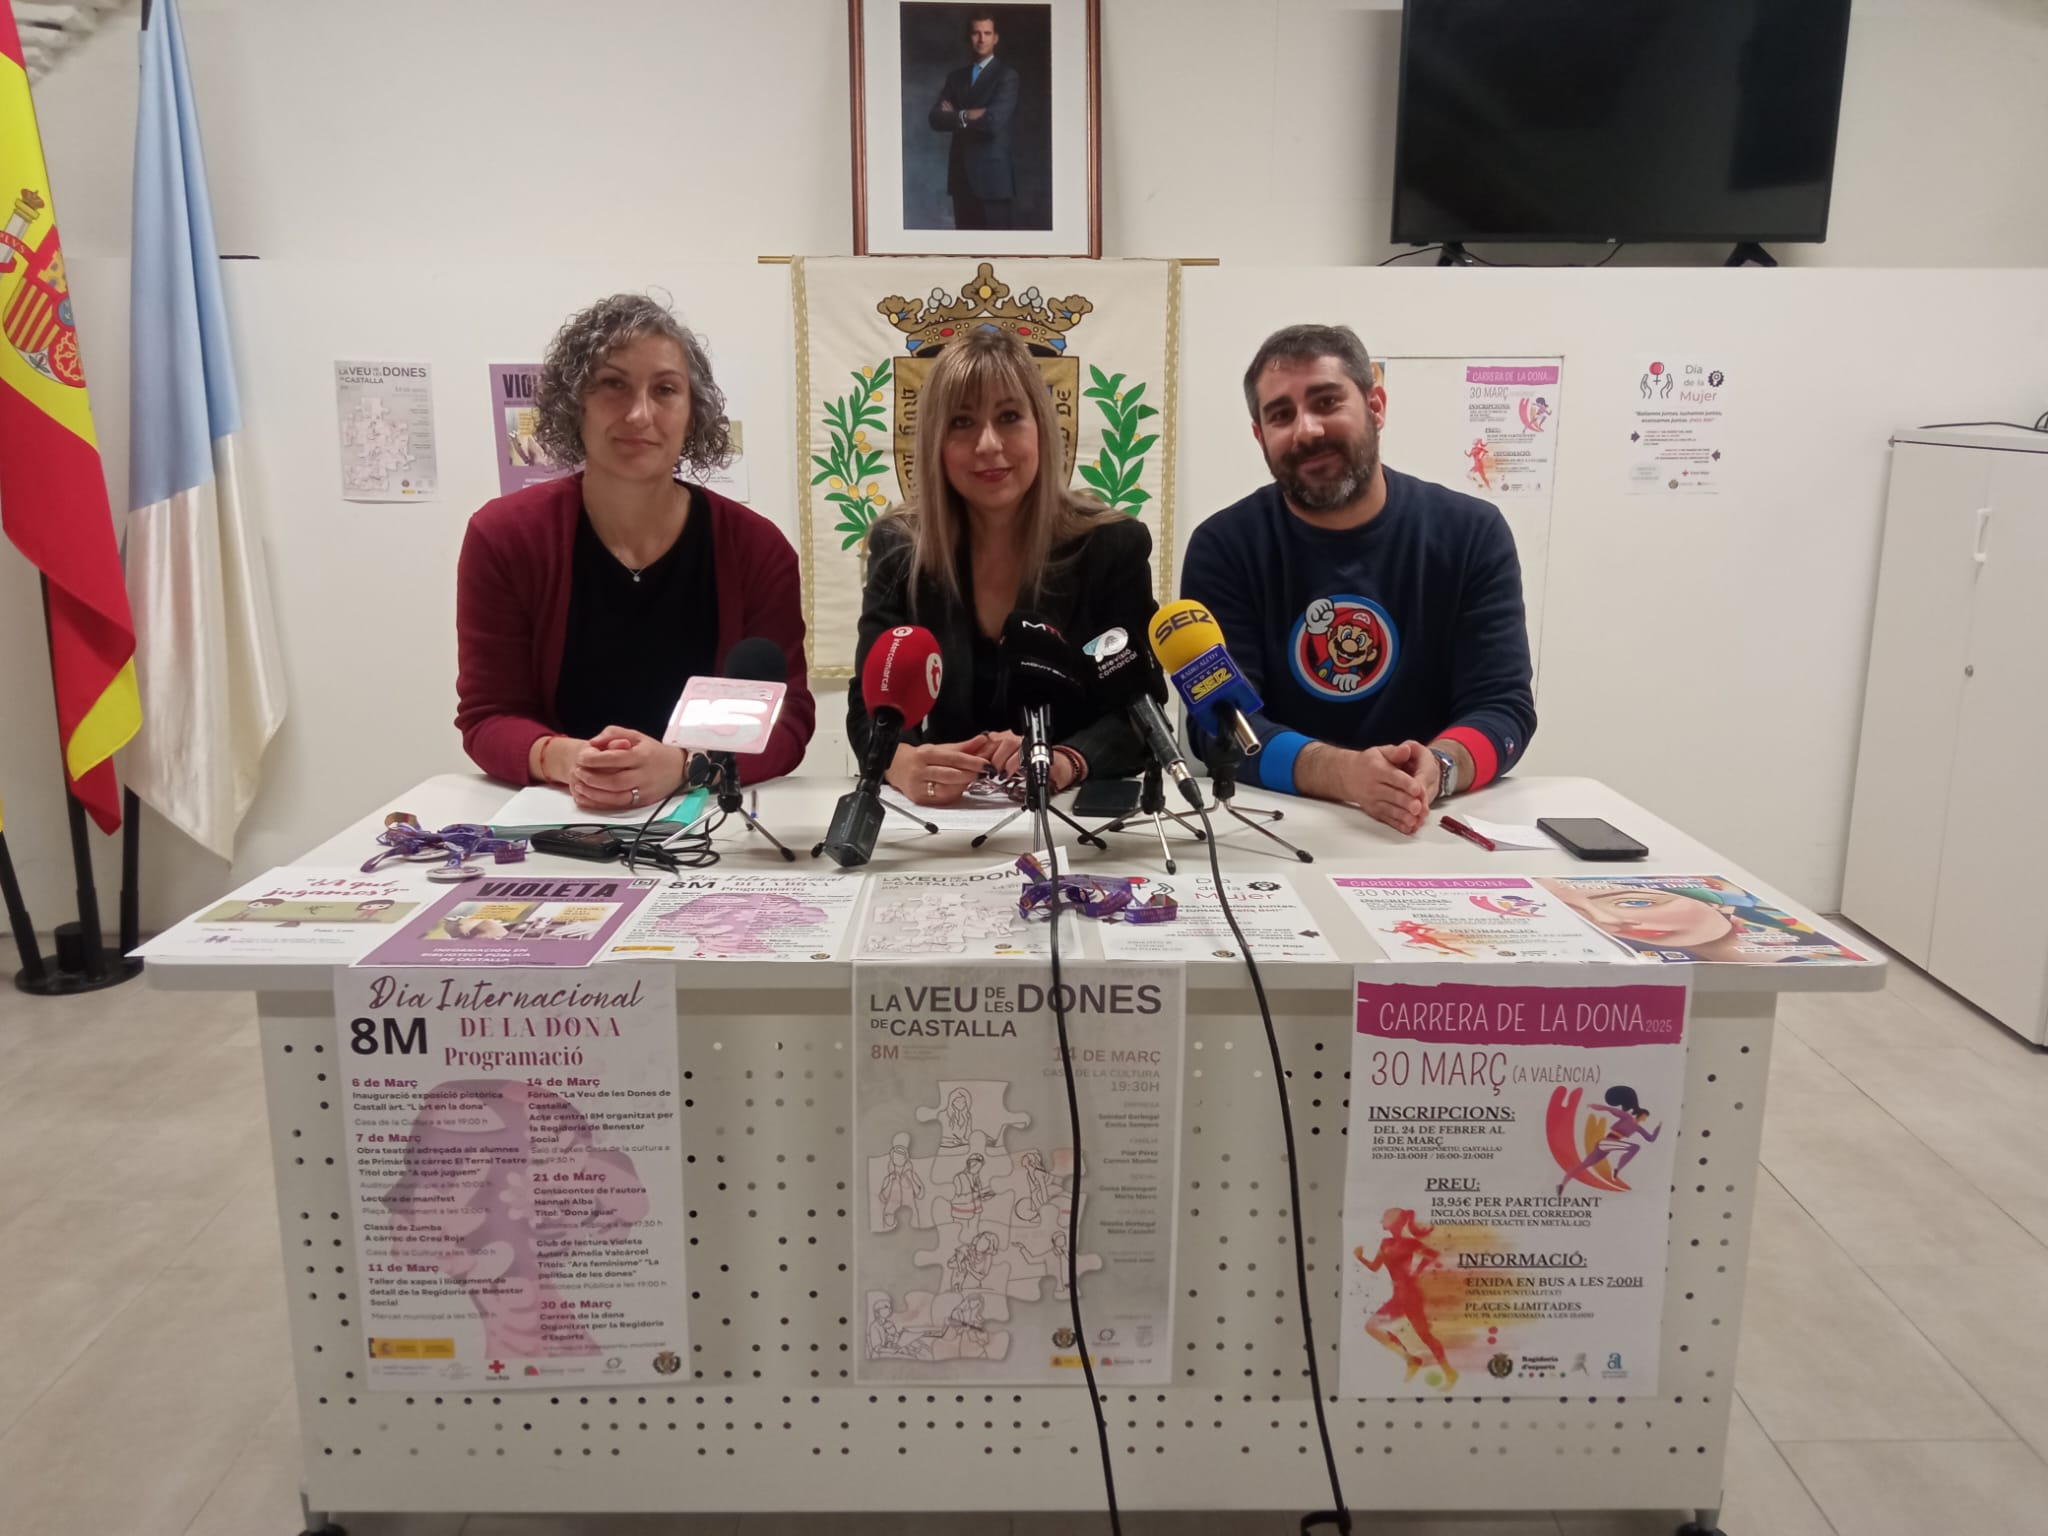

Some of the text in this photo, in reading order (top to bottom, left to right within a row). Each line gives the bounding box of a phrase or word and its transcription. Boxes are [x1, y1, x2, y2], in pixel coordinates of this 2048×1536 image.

[349, 367, 371, 376] VEU
[382, 366, 426, 377] DONES
[1685, 364, 1703, 374] Día
[344, 376, 384, 384] CASTALLA
[1517, 372, 1526, 380] LA
[1528, 371, 1548, 381] DONA
[1470, 387, 1509, 400] 30 MARÇ
[1680, 392, 1717, 404] Mujer
[1155, 609, 1213, 646] SER
[880, 638, 902, 691] intercomarcal
[1099, 651, 1138, 679] comarcal
[1190, 667, 1233, 700] SER
[668, 881, 716, 889] 8M
[1465, 880, 1506, 888] DONA
[476, 882, 619, 898] VIOLETA
[1352, 889, 1437, 898] 30 MARÇ
[436, 979, 643, 1011] Internacional
[870, 984, 1162, 1014] LA VEU DE DONES
[984, 1000, 1014, 1013] LES
[1379, 1002, 1672, 1032] CARRERA DE LA DONA 2025
[459, 1016, 621, 1038] DE LA DONA
[870, 1018, 1017, 1038] DE CASTALLA
[350, 1017, 428, 1056] 8M
[871, 1044, 898, 1060] 8M
[1083, 1050, 1106, 1063] DE
[1111, 1050, 1160, 1065] MARÇ
[444, 1047, 584, 1071] Programació
[1075, 1069, 1160, 1078] DE LA CULTURA
[1372, 1051, 1601, 1096] 30 MARÇ (A VALÈNCIA)
[352, 1078, 418, 1090] 6 de Març
[527, 1078, 600, 1088] 14 de Març
[1110, 1081, 1160, 1092] 19:30H
[352, 1092, 410, 1100] Inauguració
[353, 1103, 488, 1111] Castall dona"
[1368, 1106, 1516, 1121] INSCRIPCIONS:
[1374, 1125, 1504, 1134] DEL 24 DE FEBRER AL
[356, 1133, 422, 1144] 7 de Març
[1373, 1136, 1444, 1147] 16 DE MARÇ
[496, 1157, 527, 1165] Teatre
[533, 1172, 606, 1183] 21 de Març
[1425, 1178, 1480, 1192] PREU:
[1431, 1197, 1602, 1208] 13,95€ PER PARTICIPANT
[1430, 1209, 1592, 1218] INCLÒS BOLSA DEL CORREDOR
[1457, 1250, 1588, 1268] INFORMACIÓ:
[368, 1264, 439, 1274] 11 de Març
[1466, 1277, 1643, 1287] EIXIDA EN BUS A LES 7:00H
[541, 1300, 613, 1310] 30 de Març
[1465, 1302, 1582, 1312] PLACES LIMITADES
[620, 1321, 664, 1329] Regidoria
